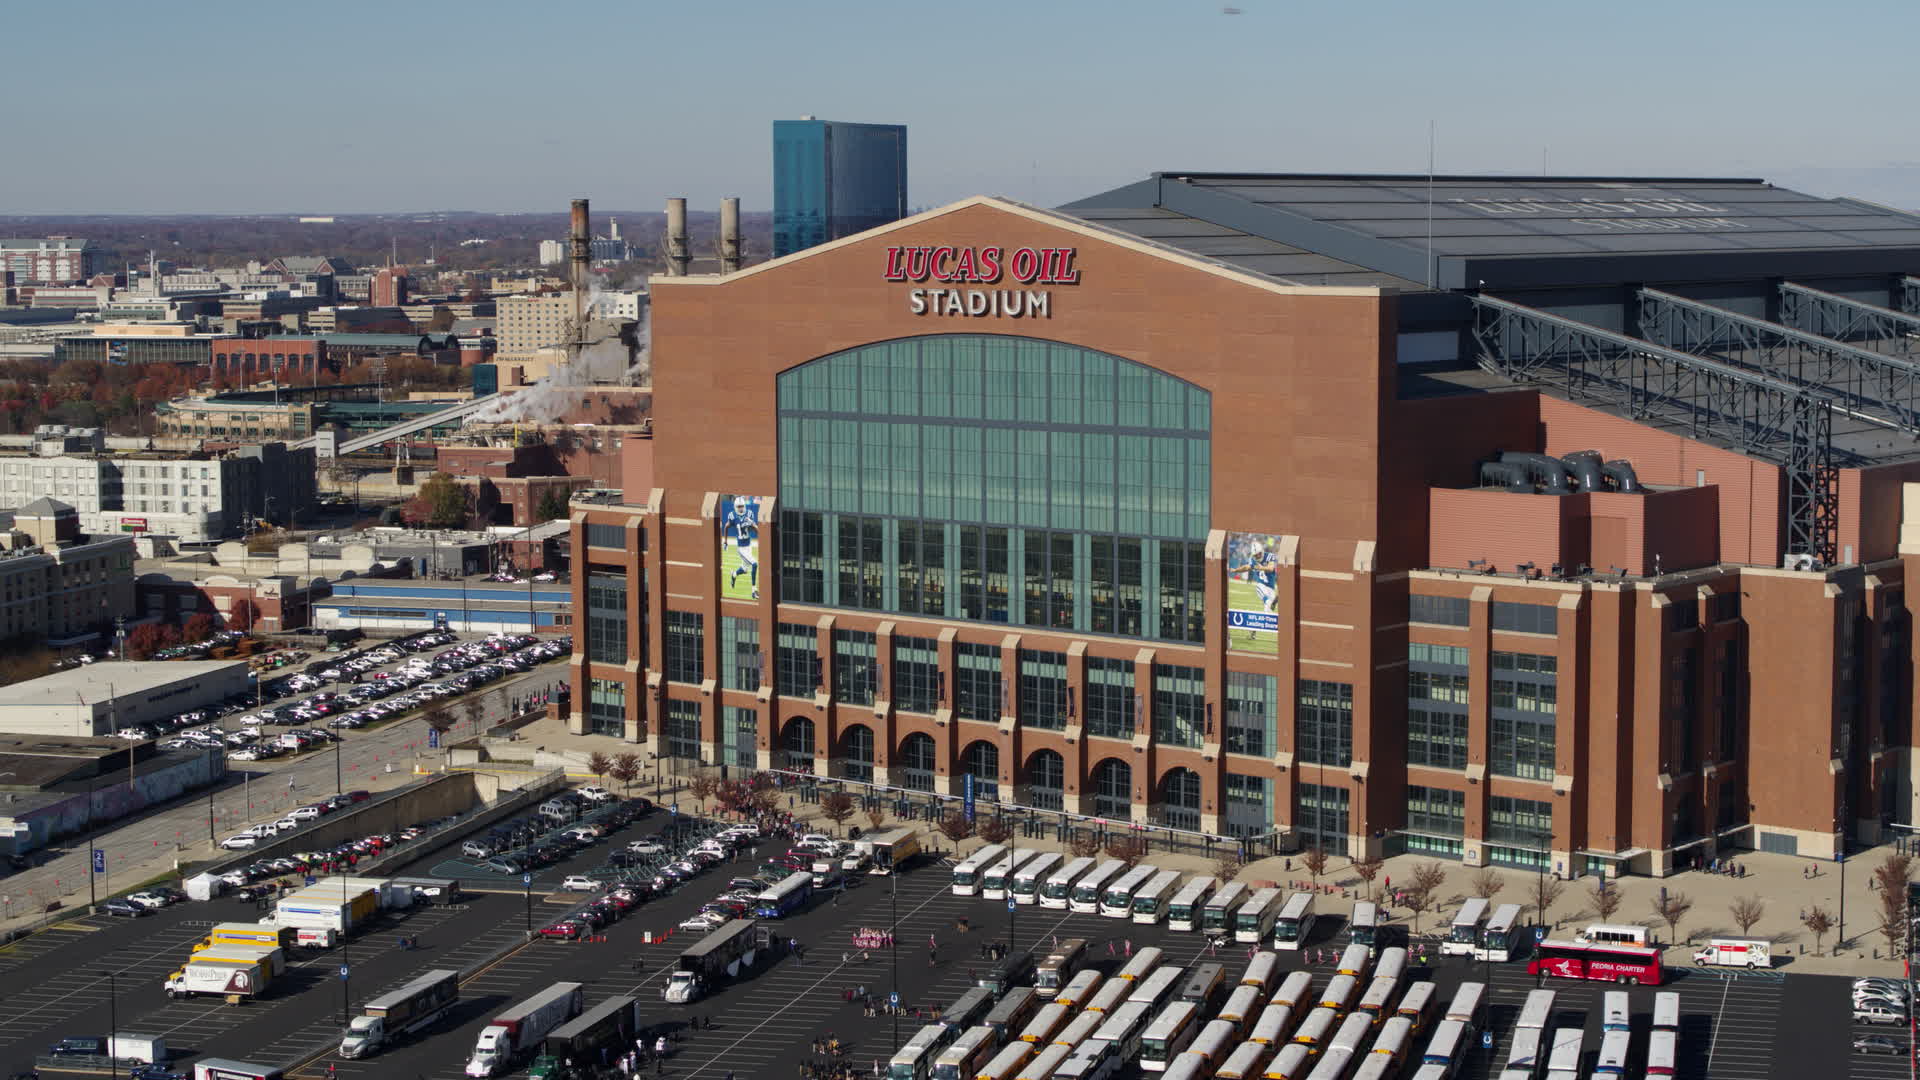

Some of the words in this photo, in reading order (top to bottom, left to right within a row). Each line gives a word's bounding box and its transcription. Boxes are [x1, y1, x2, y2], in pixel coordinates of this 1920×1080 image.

[884, 246, 1000, 282] LUCAS
[1011, 247, 1078, 283] OIL
[910, 288, 1049, 317] STADIUM
[1591, 962, 1614, 970] PEORIA
[1616, 965, 1645, 973] CHARTER
